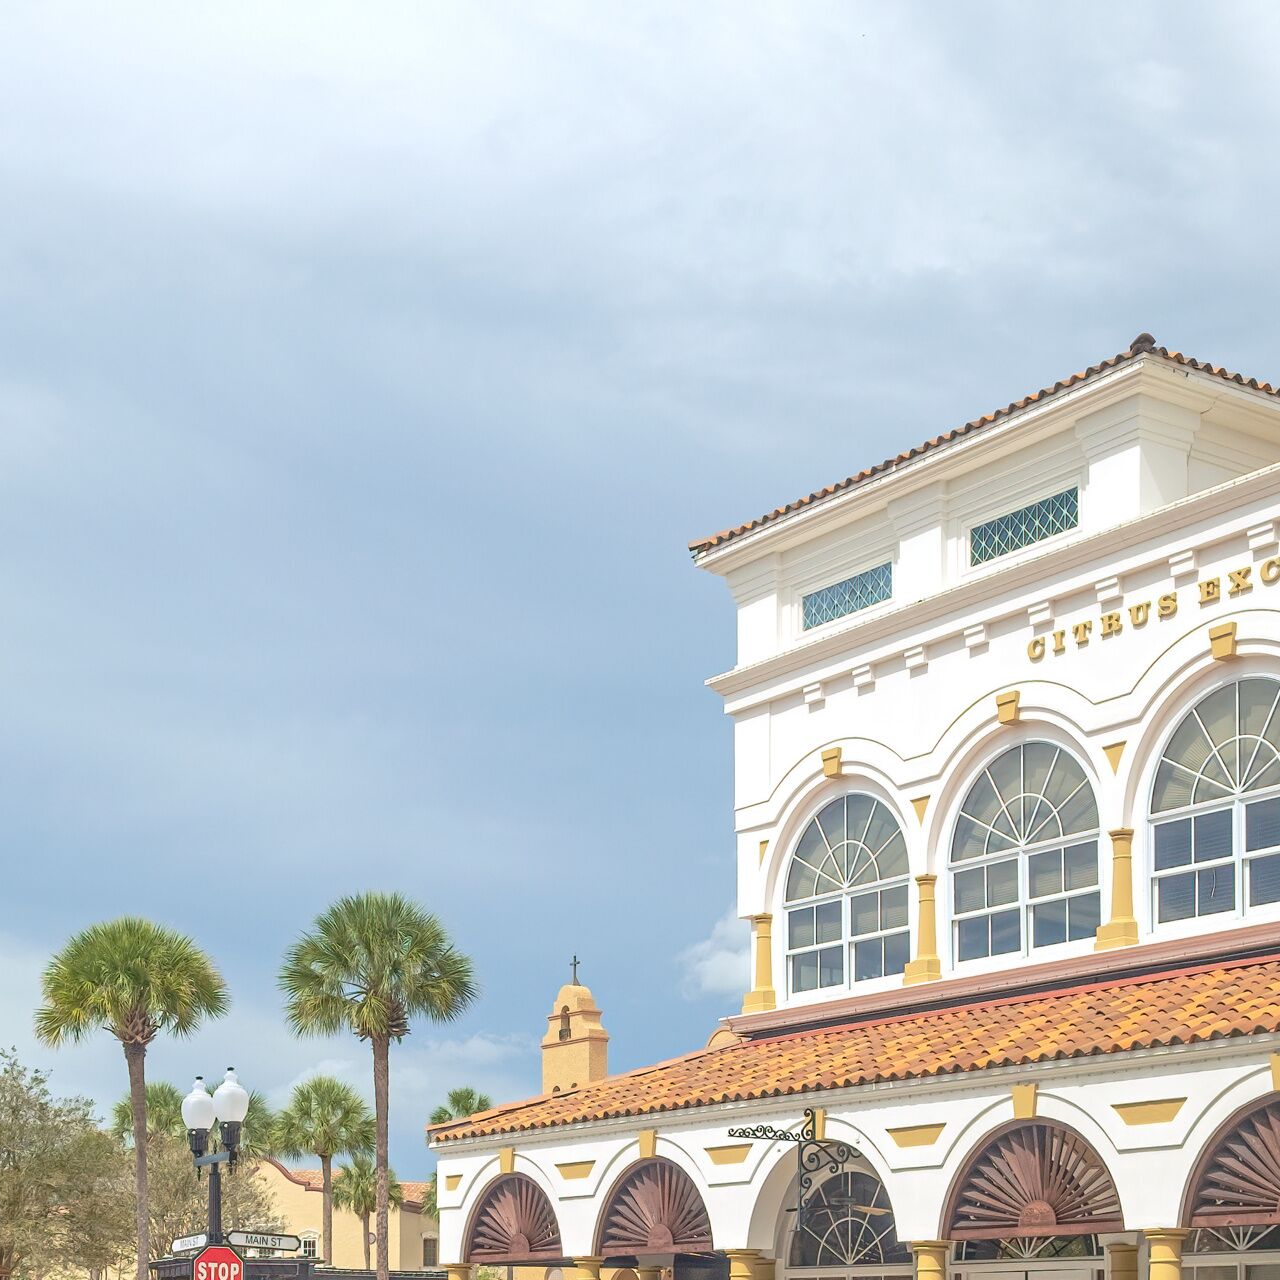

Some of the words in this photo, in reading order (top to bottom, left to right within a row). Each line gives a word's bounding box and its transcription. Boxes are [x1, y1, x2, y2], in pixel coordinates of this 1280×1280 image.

[1027, 592, 1178, 661] CITRUS
[180, 1239, 192, 1247] MAIN
[192, 1237, 199, 1245] ST
[245, 1235, 268, 1246] MAIN
[271, 1237, 282, 1247] ST
